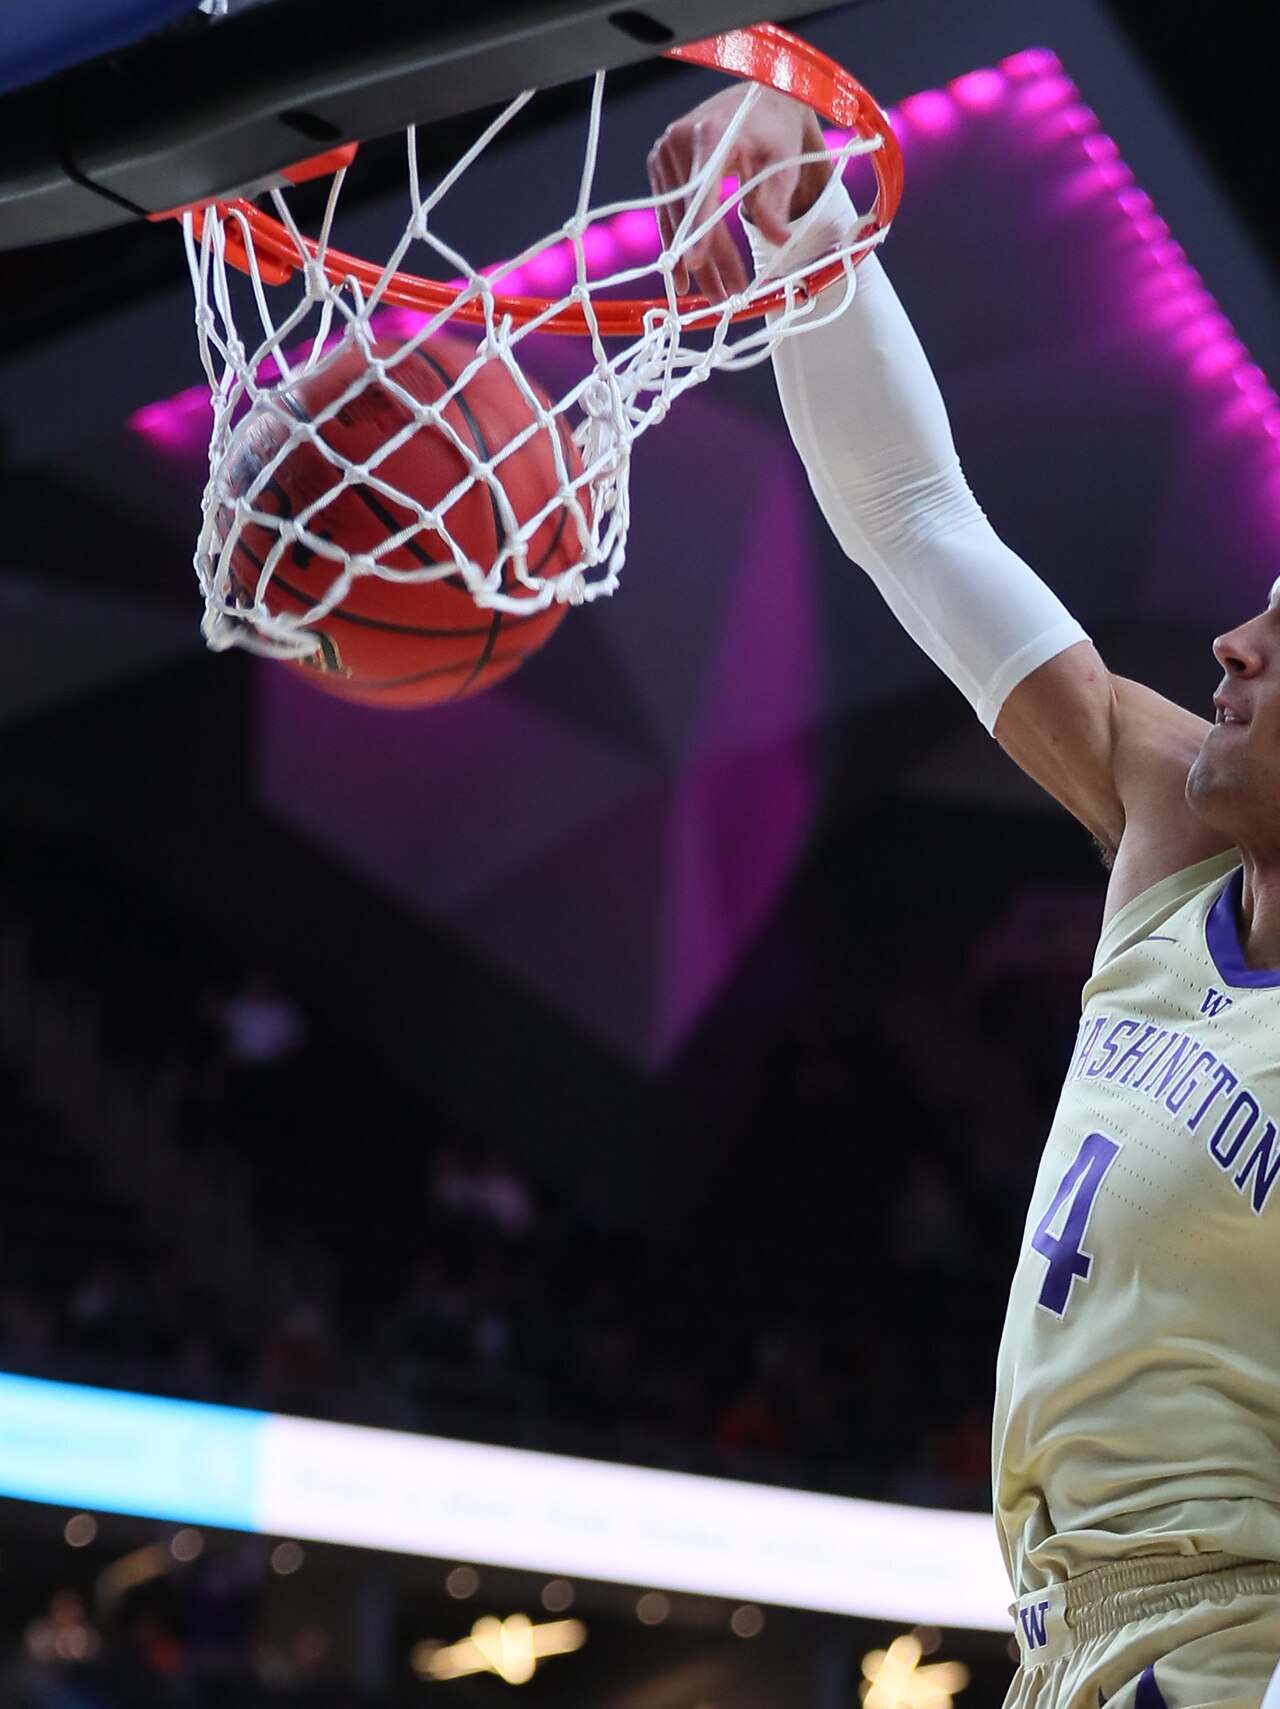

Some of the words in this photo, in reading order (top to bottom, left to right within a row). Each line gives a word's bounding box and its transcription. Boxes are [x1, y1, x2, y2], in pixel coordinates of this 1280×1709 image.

[1201, 988, 1232, 1017] W
[1031, 1129, 1123, 1320] 4
[1019, 1600, 1050, 1651] W
